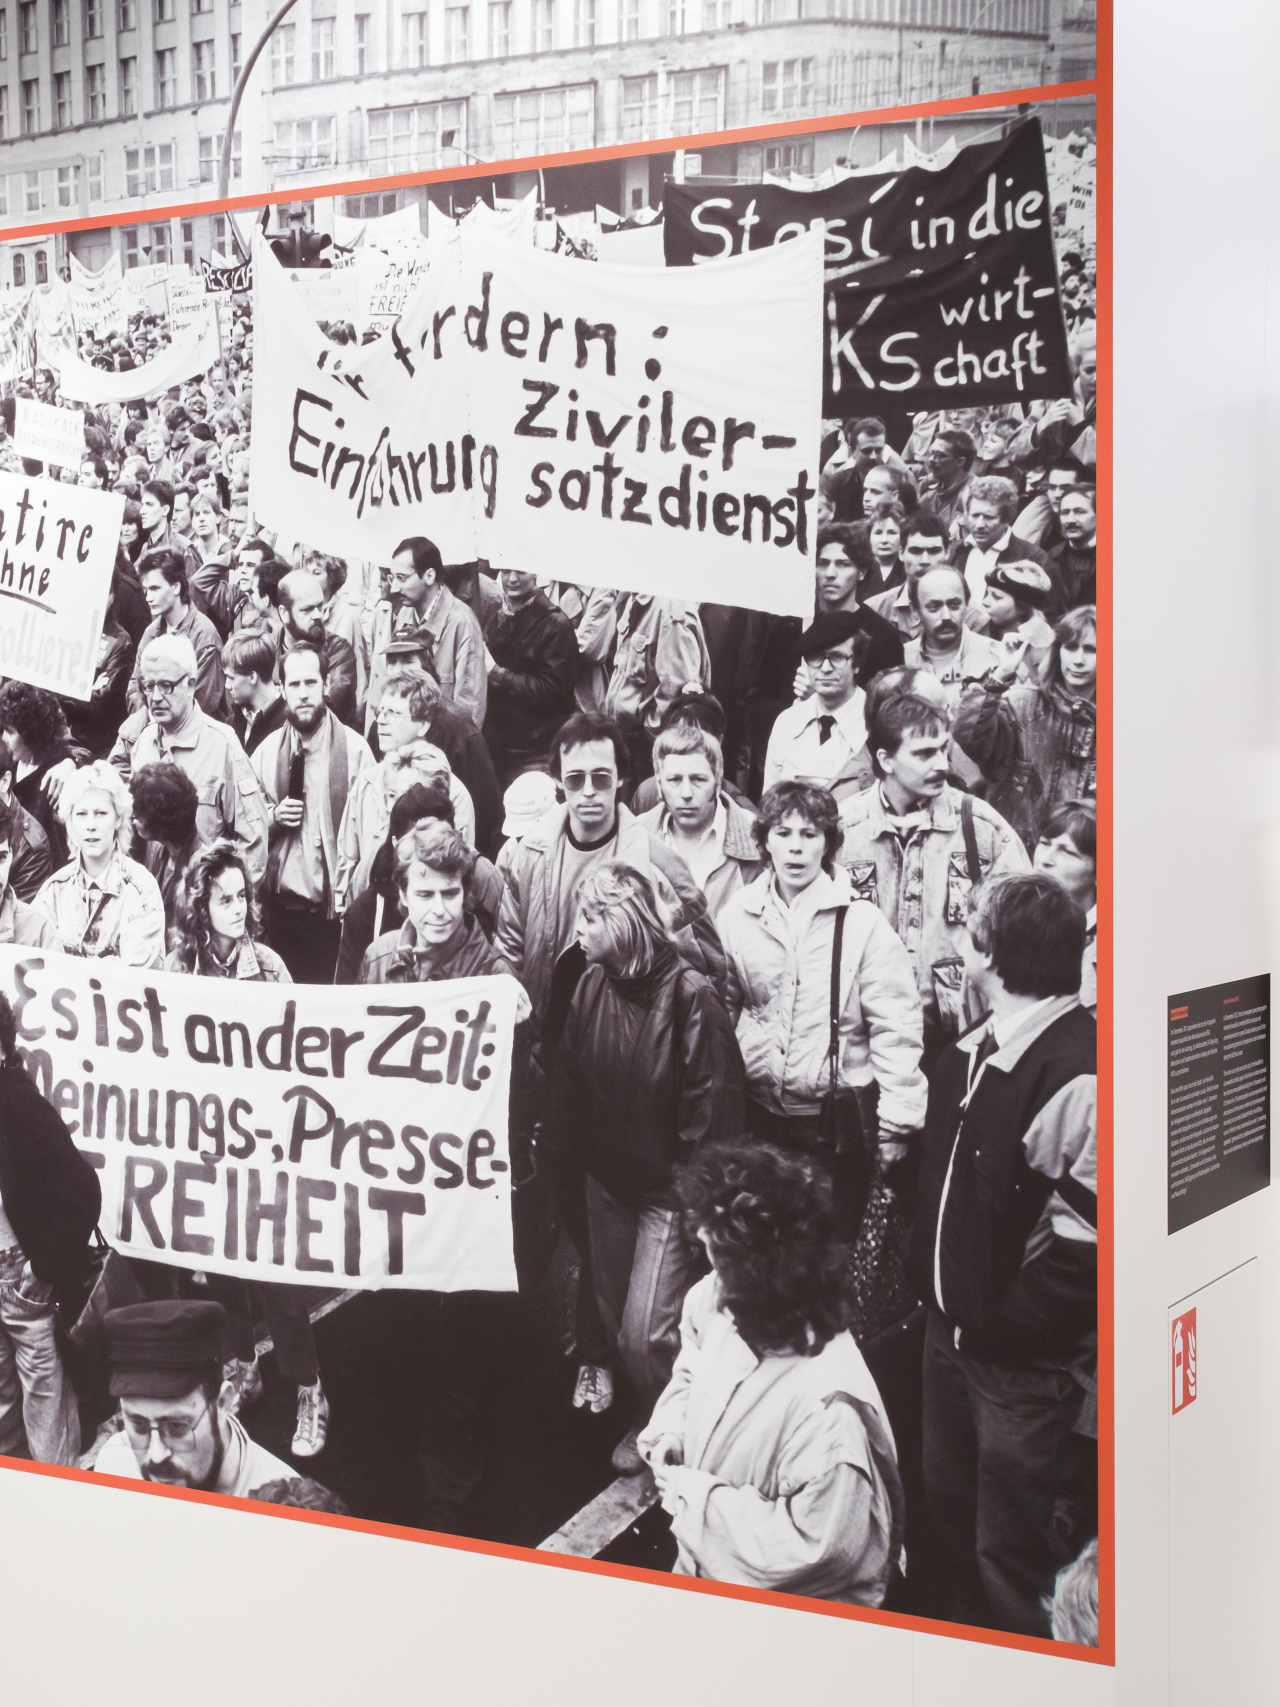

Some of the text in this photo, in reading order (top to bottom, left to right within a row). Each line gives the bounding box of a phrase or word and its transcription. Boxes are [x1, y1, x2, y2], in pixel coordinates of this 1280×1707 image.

[911, 196, 955, 249] in
[968, 173, 1044, 240] die
[384, 263, 404, 278] Die
[940, 265, 1055, 327] wirt-
[391, 272, 670, 380] frdern:
[22, 407, 81, 437] RADIKALE
[514, 379, 798, 471] Ziviler-
[525, 450, 816, 555] satzdienst
[13, 957, 79, 1042] Es
[89, 977, 169, 1058] ist
[366, 1000, 497, 1091] Zeit:
